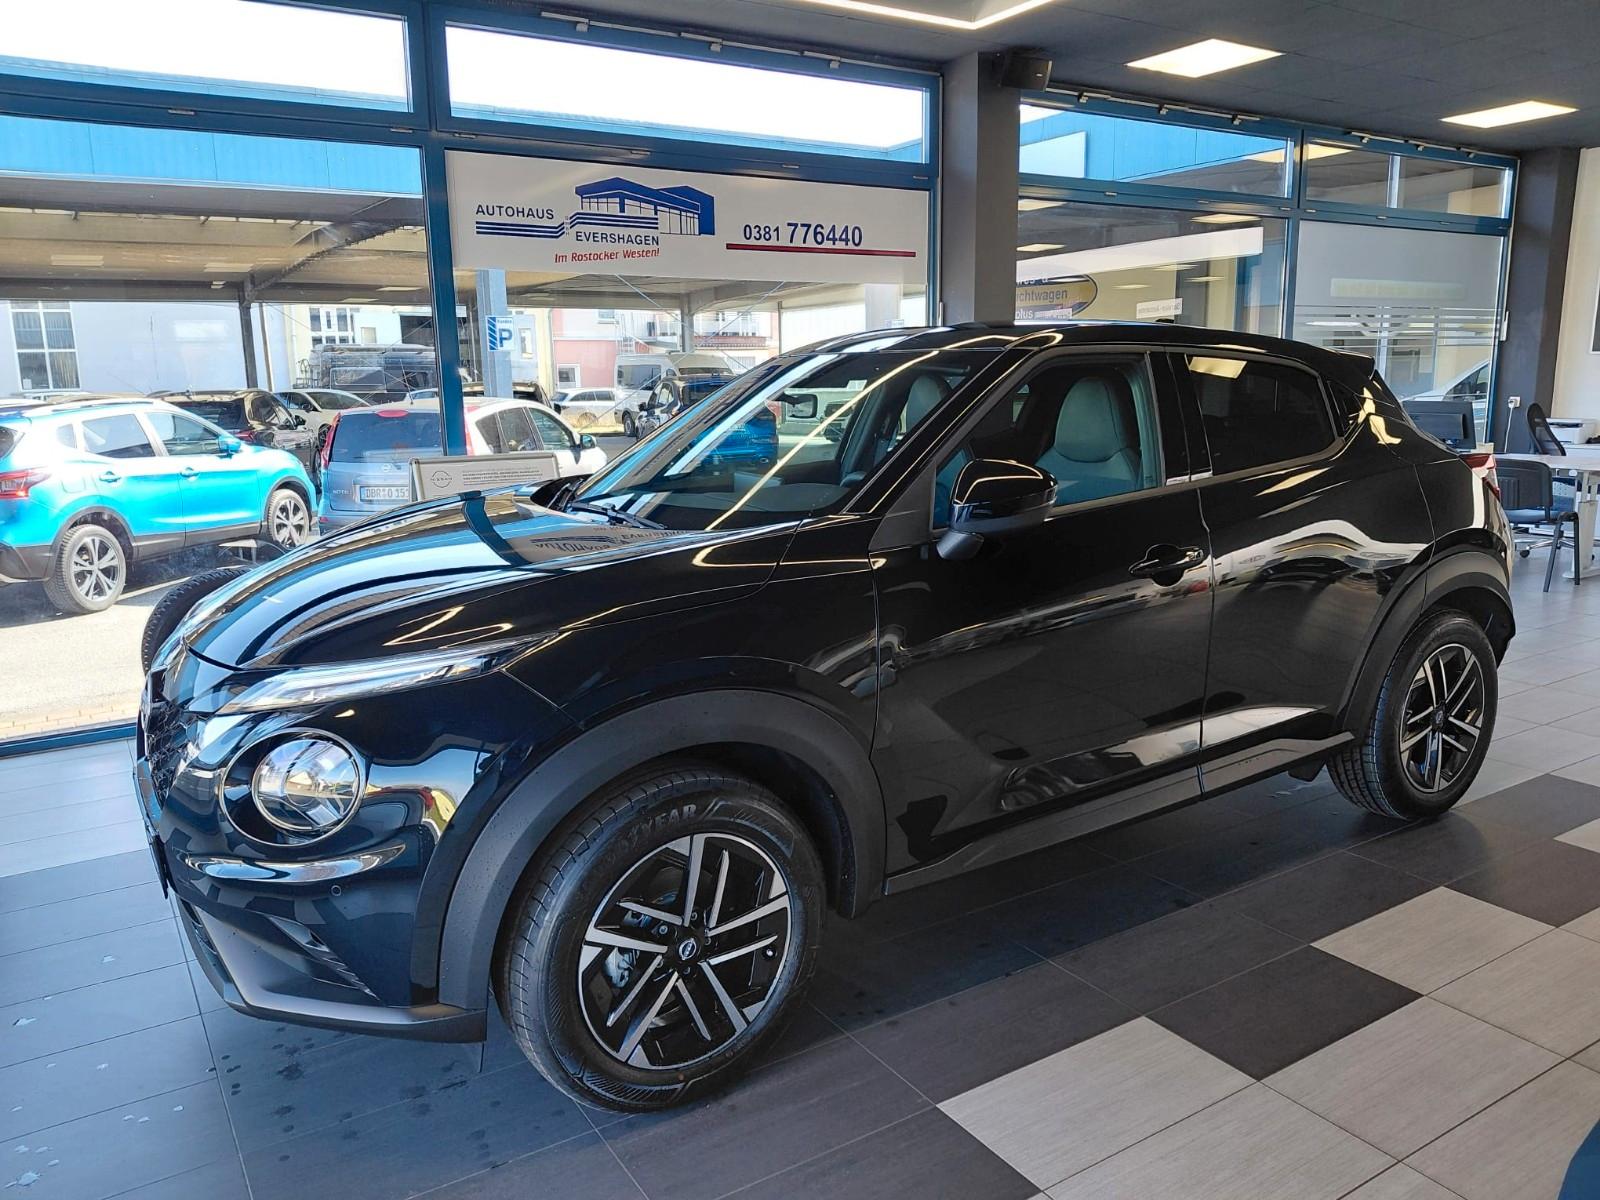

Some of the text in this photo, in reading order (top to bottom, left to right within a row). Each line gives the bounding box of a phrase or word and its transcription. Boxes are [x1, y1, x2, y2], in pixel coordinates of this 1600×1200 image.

[476, 204, 554, 220] AUTOHAUS
[575, 231, 659, 246] EVERSHAGEN
[743, 222, 863, 247] 0381 776440
[554, 248, 660, 263] Im Rostocker Westen!
[499, 328, 513, 347] P
